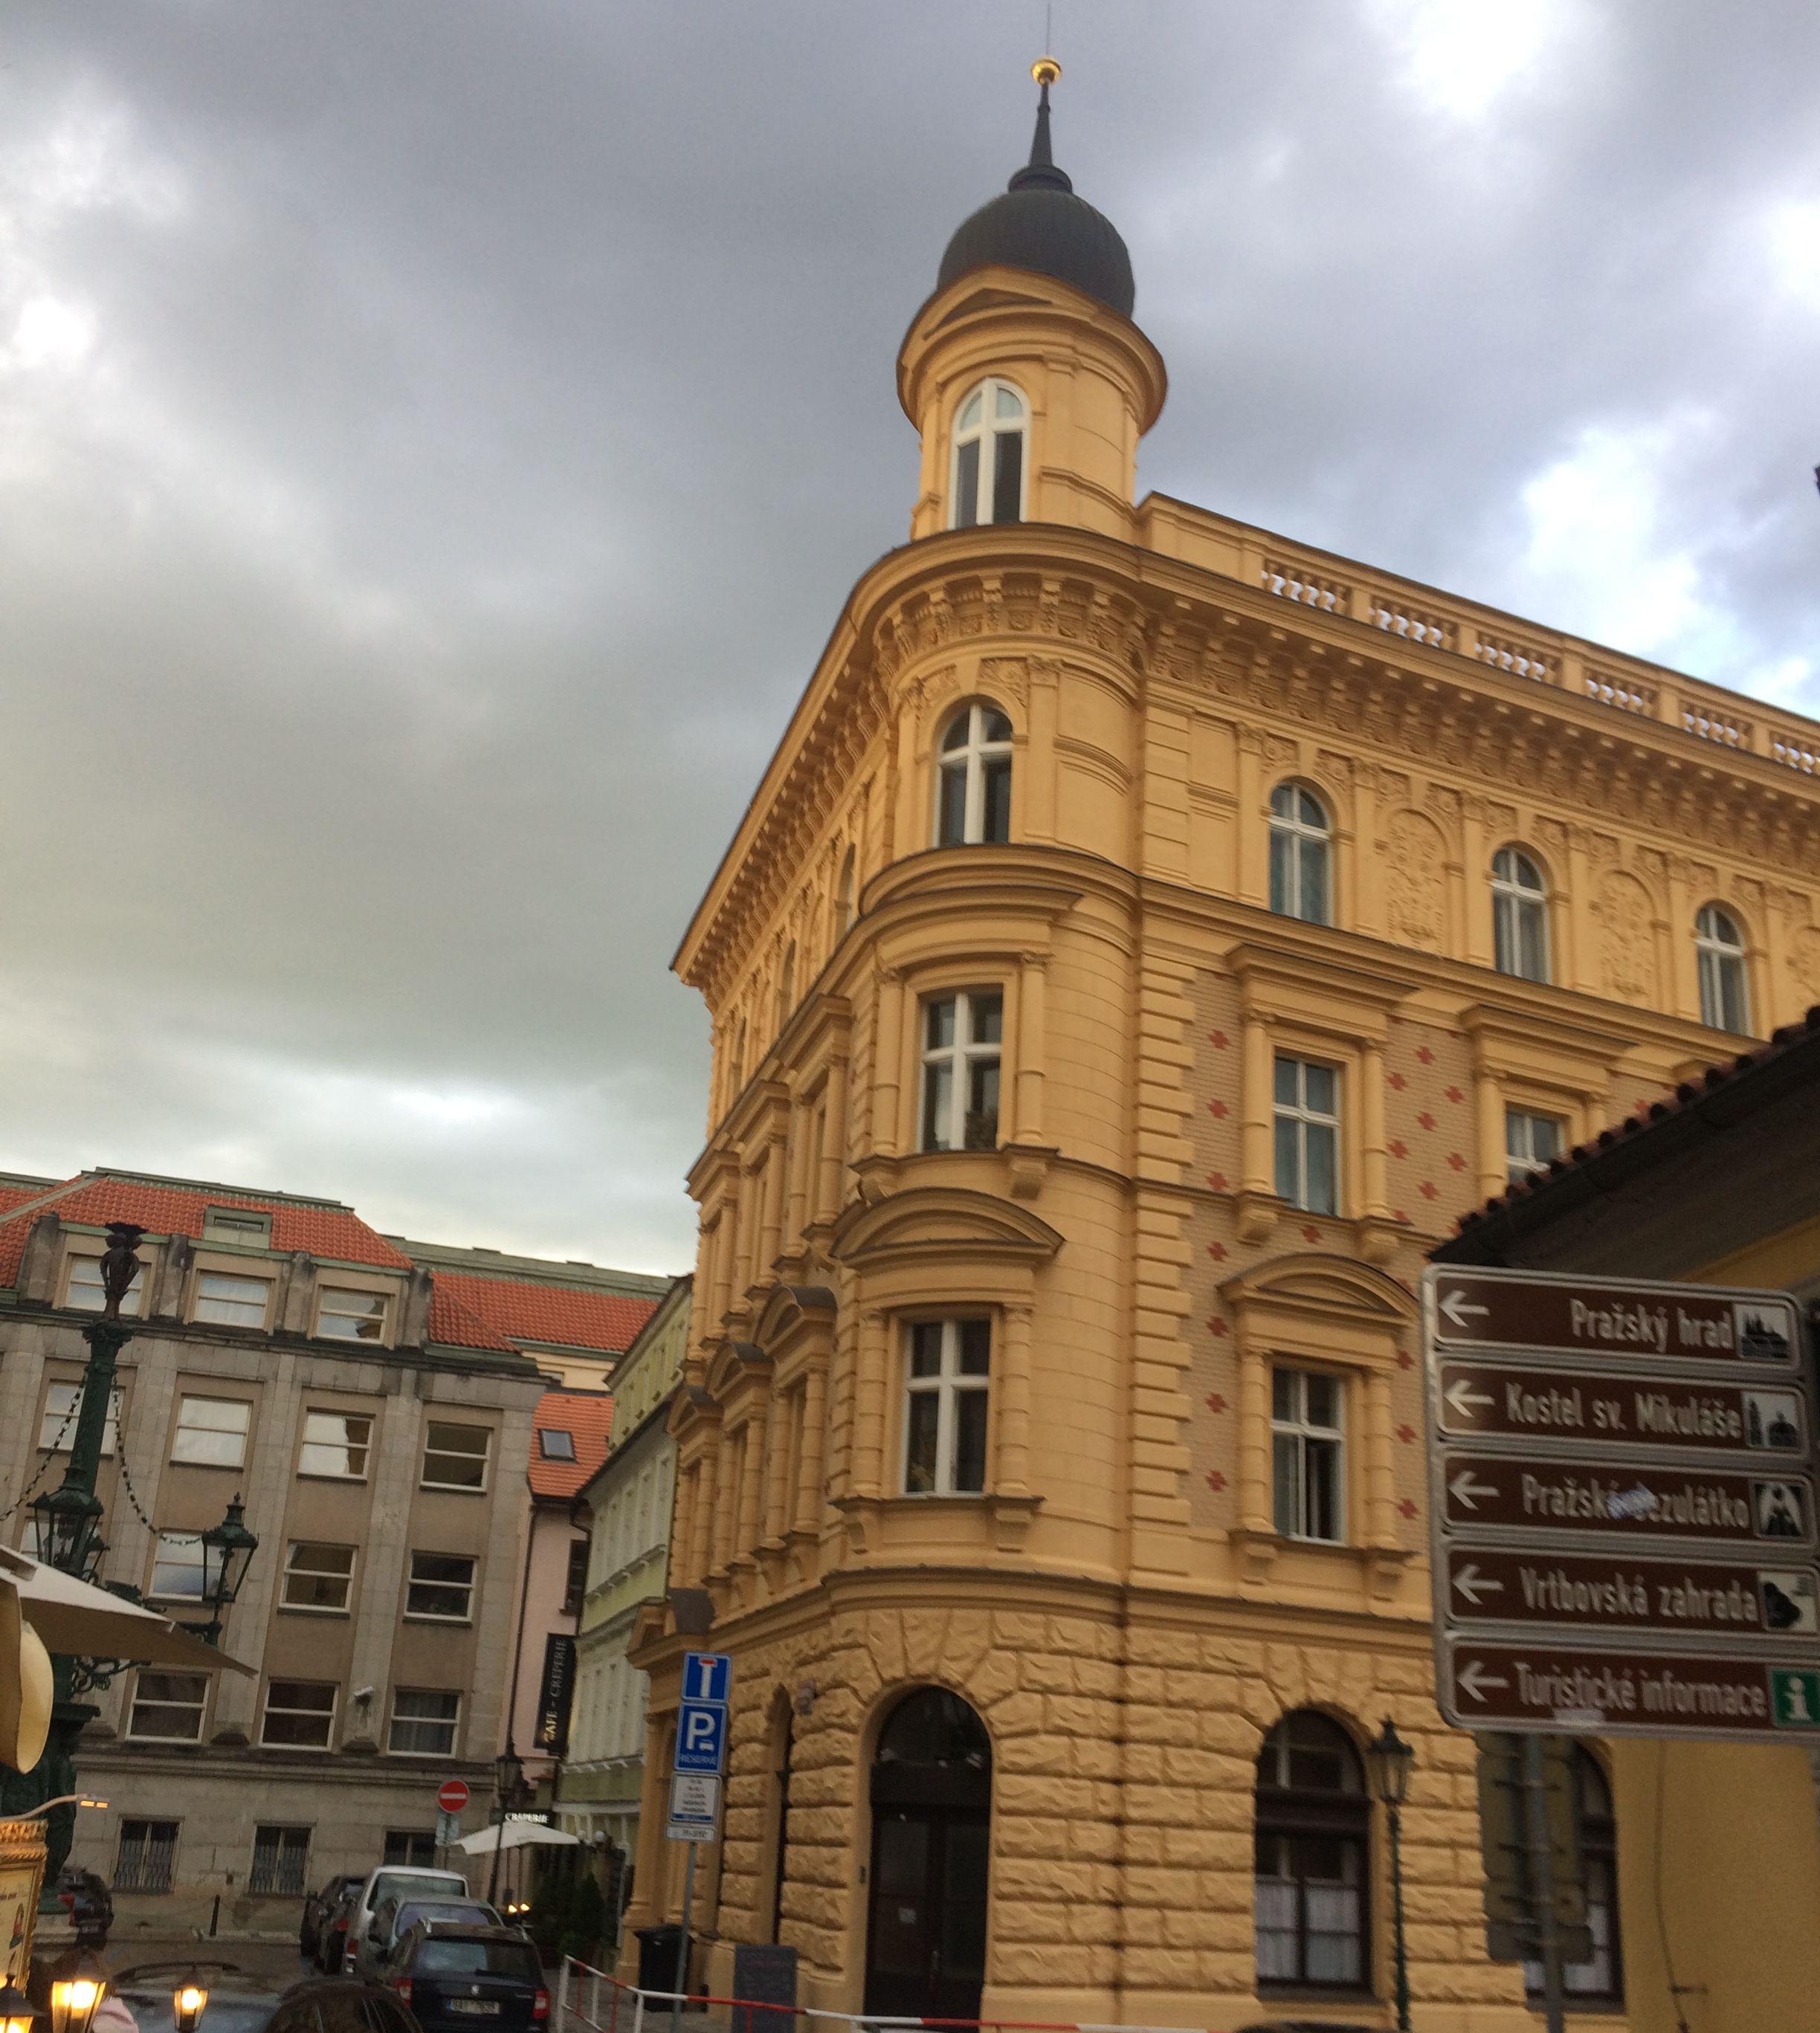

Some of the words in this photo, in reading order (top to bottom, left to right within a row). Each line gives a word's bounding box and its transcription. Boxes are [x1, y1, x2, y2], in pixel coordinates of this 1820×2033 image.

[1569, 1298, 1668, 1354] Pražský
[1677, 1307, 1735, 1350] hrad
[1505, 1381, 1585, 1427] Kostel
[1591, 1398, 1627, 1430] sv.
[1633, 1392, 1742, 1439] Mikuláše
[1522, 1473, 1621, 1519] Pražsk
[1519, 1566, 1650, 1616] Vrtbovská
[1658, 1576, 1759, 1622] zahrada
[1514, 1661, 1636, 1710] Turistické
[1639, 1669, 1766, 1717] informace
[686, 1711, 715, 1750] P
